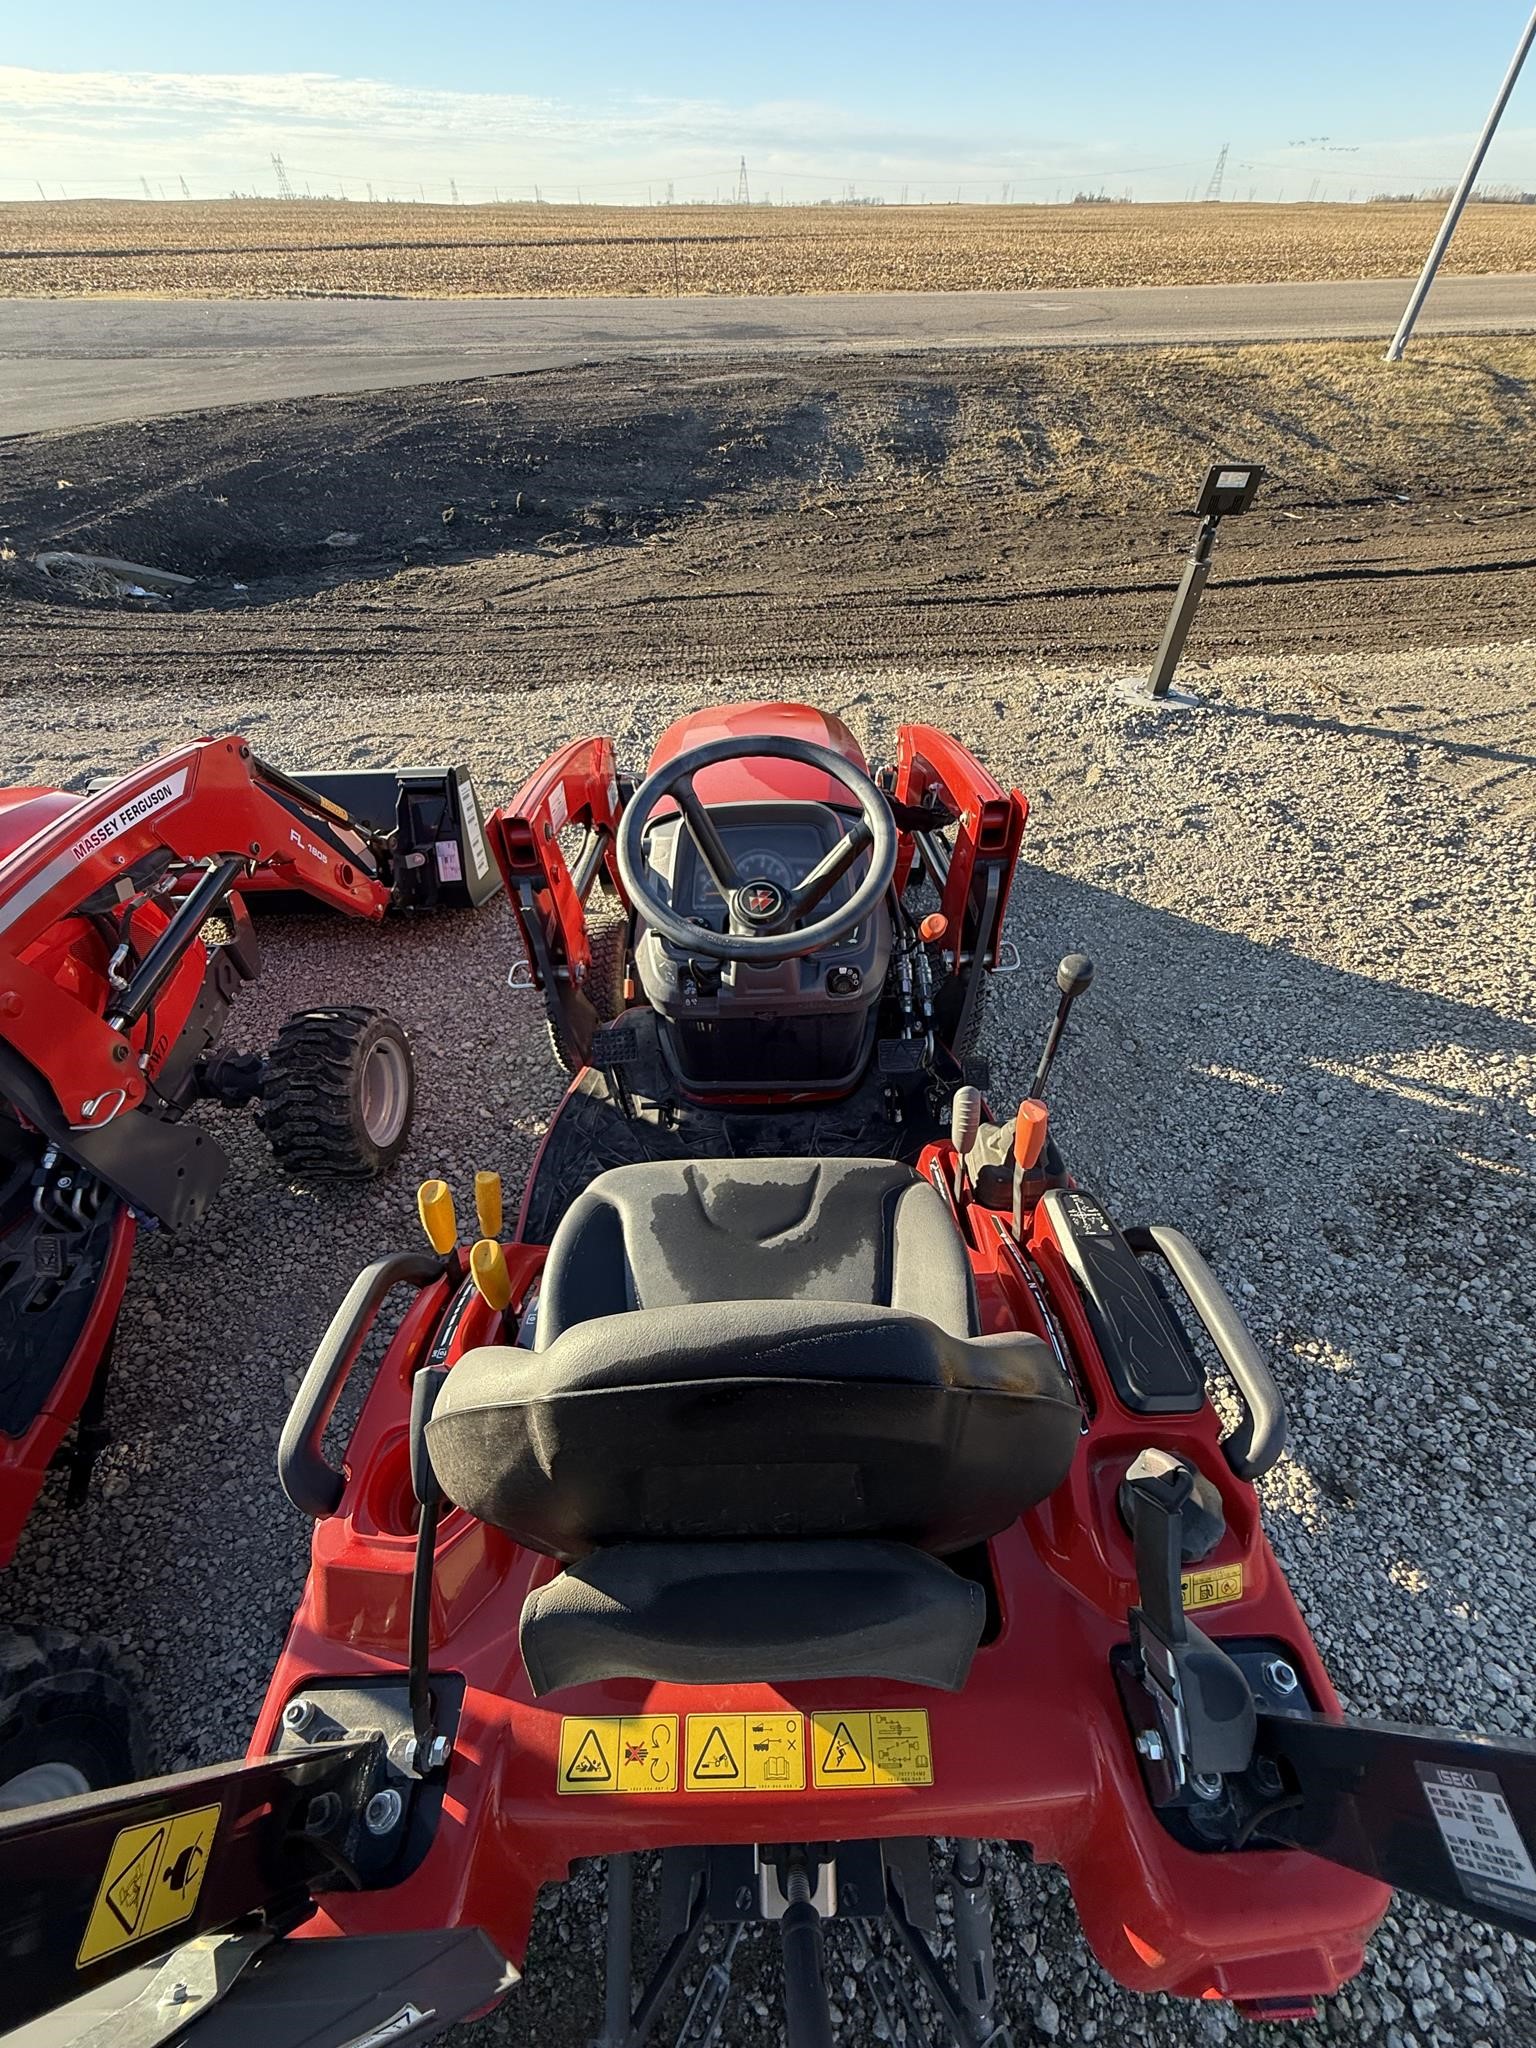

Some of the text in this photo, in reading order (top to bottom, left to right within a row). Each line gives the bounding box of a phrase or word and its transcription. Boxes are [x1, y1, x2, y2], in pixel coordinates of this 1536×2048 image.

[72, 785, 172, 860] MASSEY FERGUSON
[290, 828, 305, 849] FL
[1436, 1769, 1478, 1789] ISEKI
